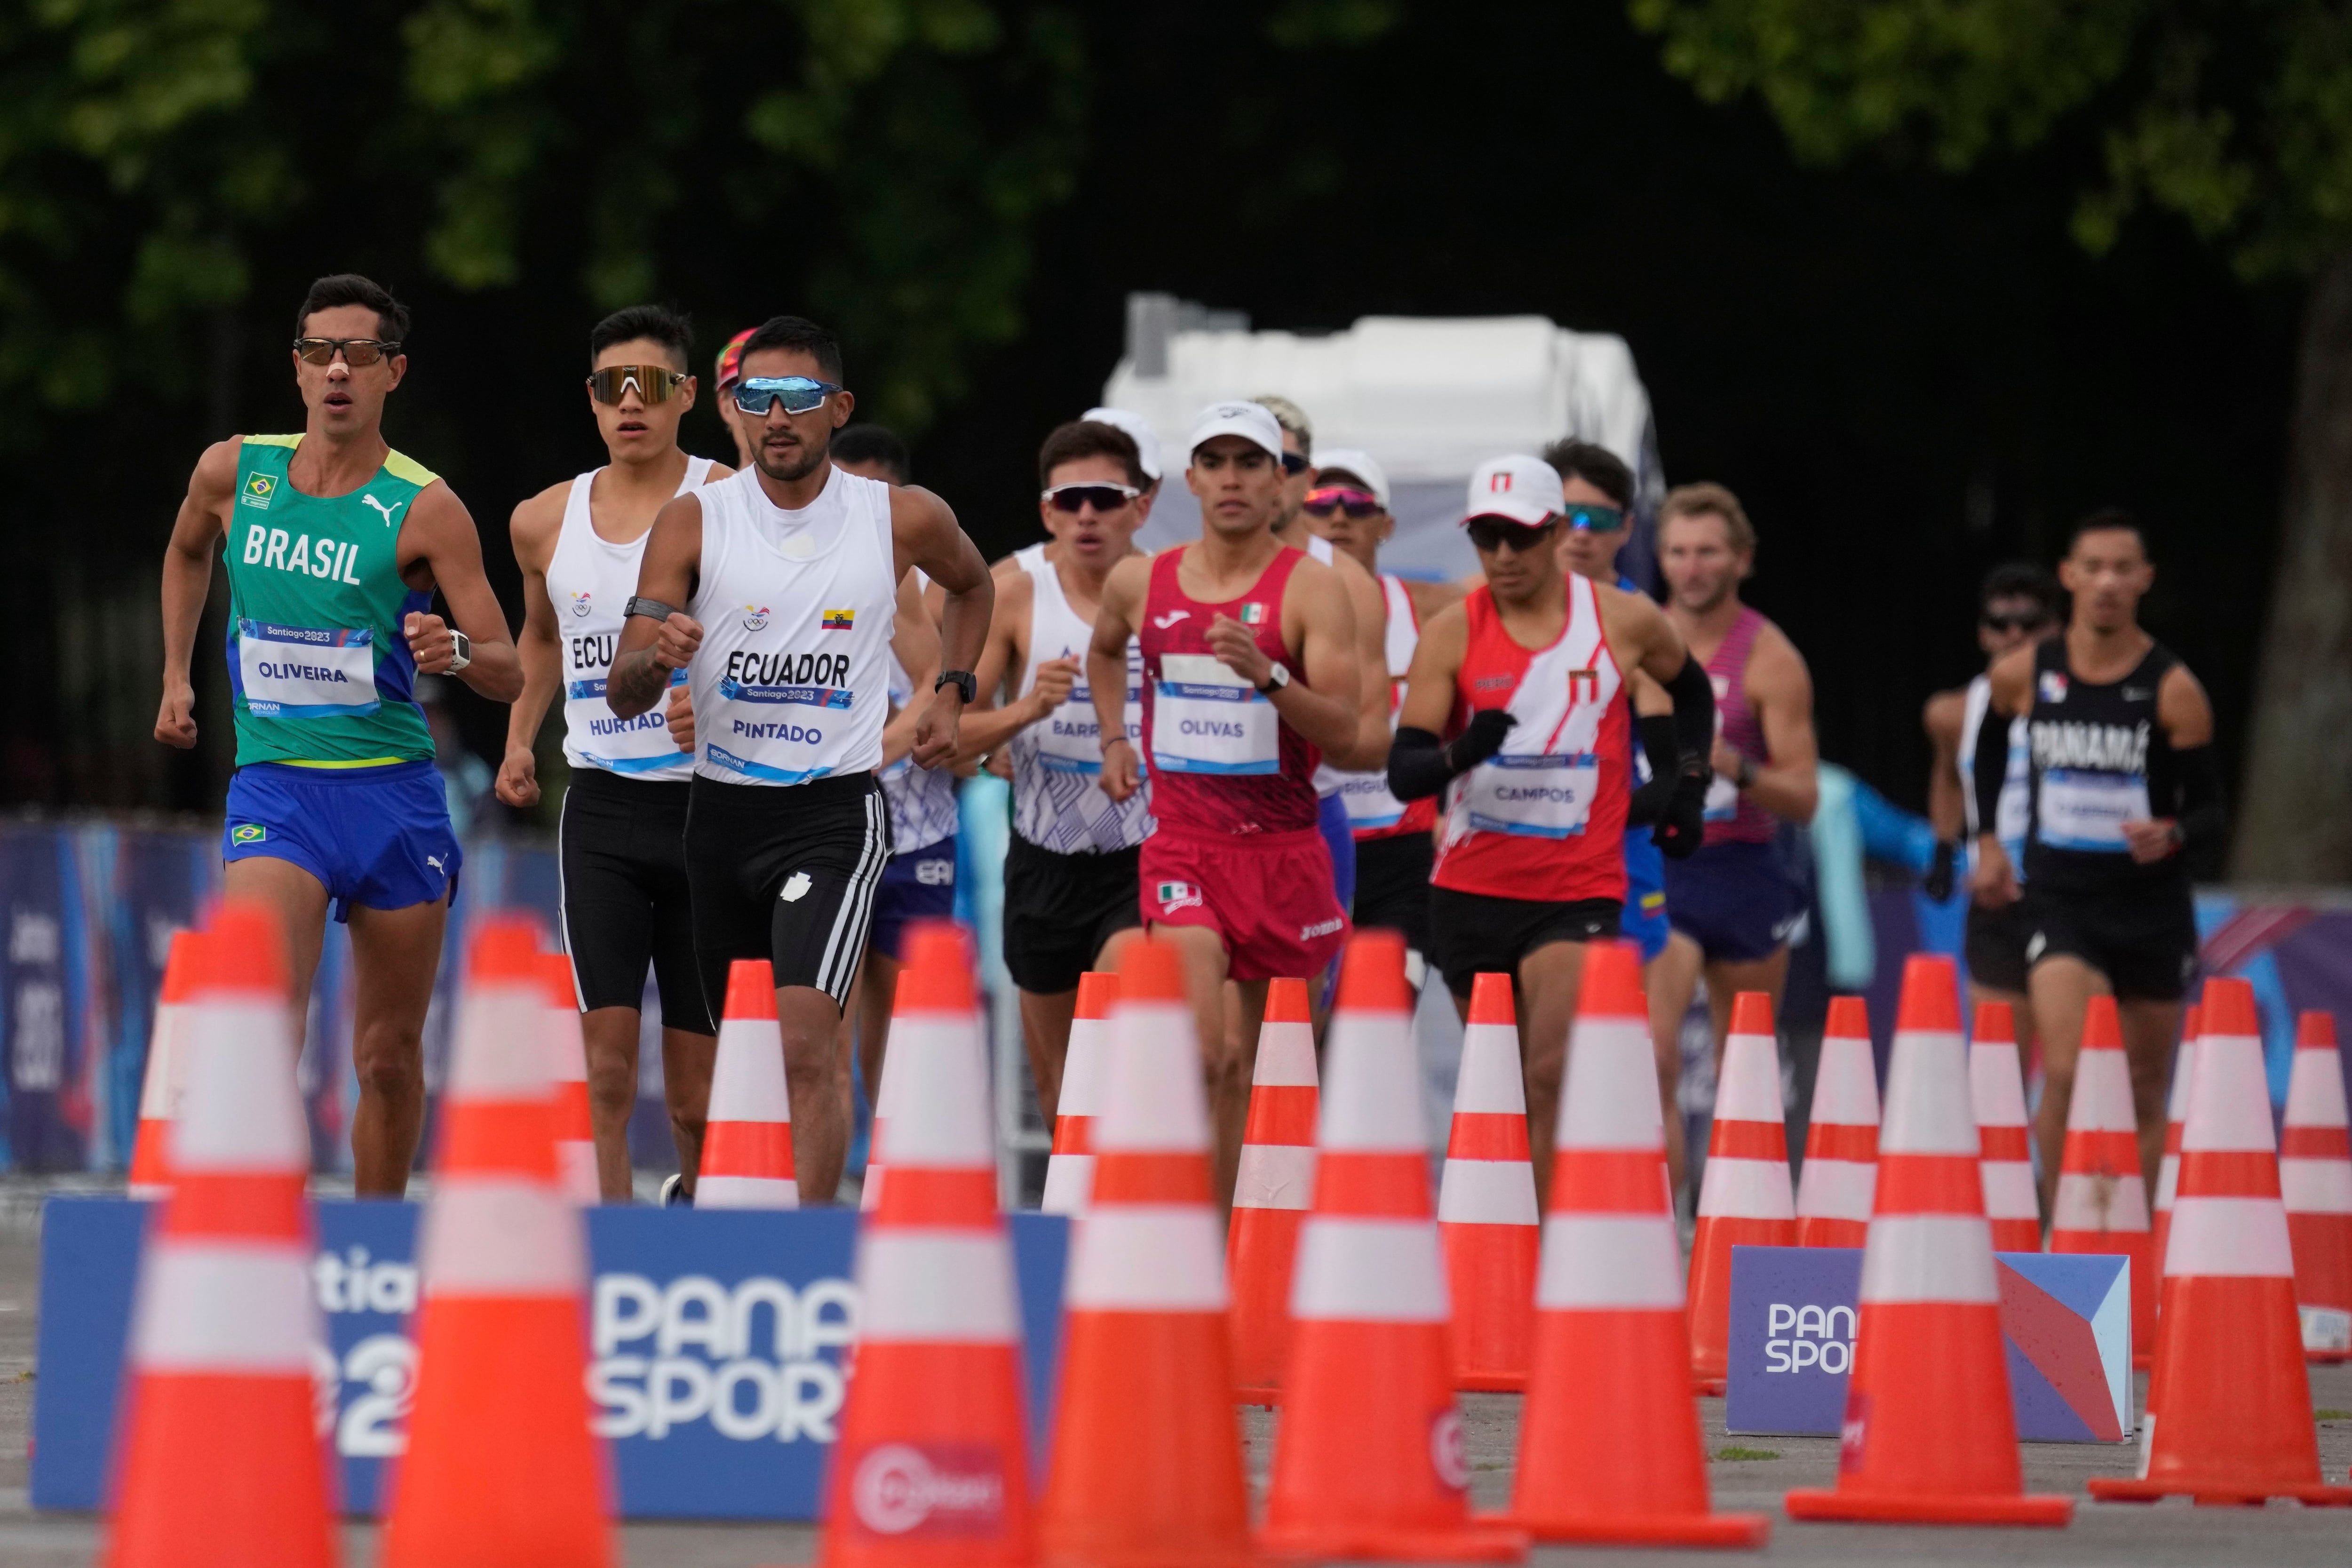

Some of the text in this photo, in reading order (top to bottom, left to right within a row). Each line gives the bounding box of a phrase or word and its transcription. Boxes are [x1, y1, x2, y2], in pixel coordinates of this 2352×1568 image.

[243, 524, 360, 585] BRASIL
[573, 636, 612, 669] ECU
[259, 662, 349, 683] OLIVEIRA
[727, 651, 850, 688] ECUADOR
[590, 712, 665, 735] HURTAD
[733, 719, 822, 745] PINTADO
[1181, 720, 1245, 738] OLIVAS
[710, 748, 745, 769] BORNAN
[1495, 786, 1575, 804] CAMPOS
